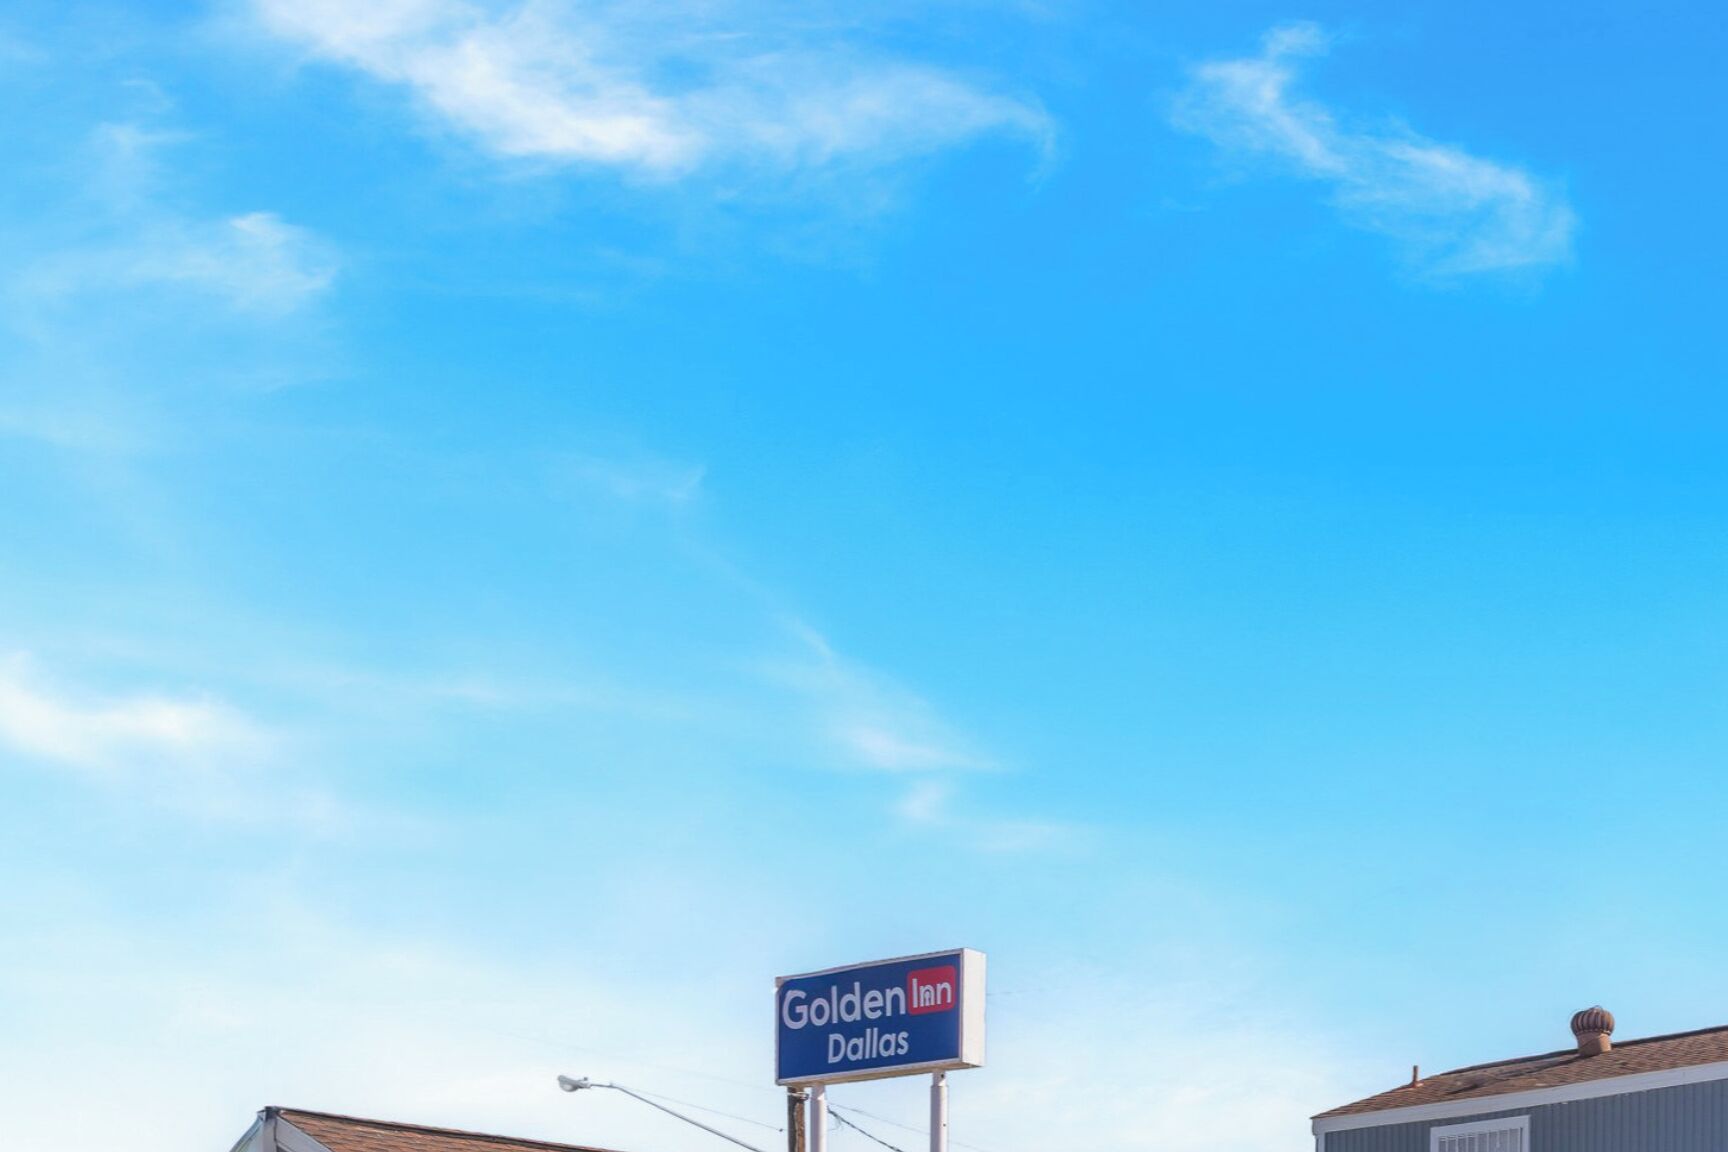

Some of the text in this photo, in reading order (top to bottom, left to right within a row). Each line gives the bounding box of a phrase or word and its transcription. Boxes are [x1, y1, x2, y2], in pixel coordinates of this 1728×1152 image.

[782, 978, 952, 1029] Golden Inn
[828, 1027, 909, 1064] Dallas
